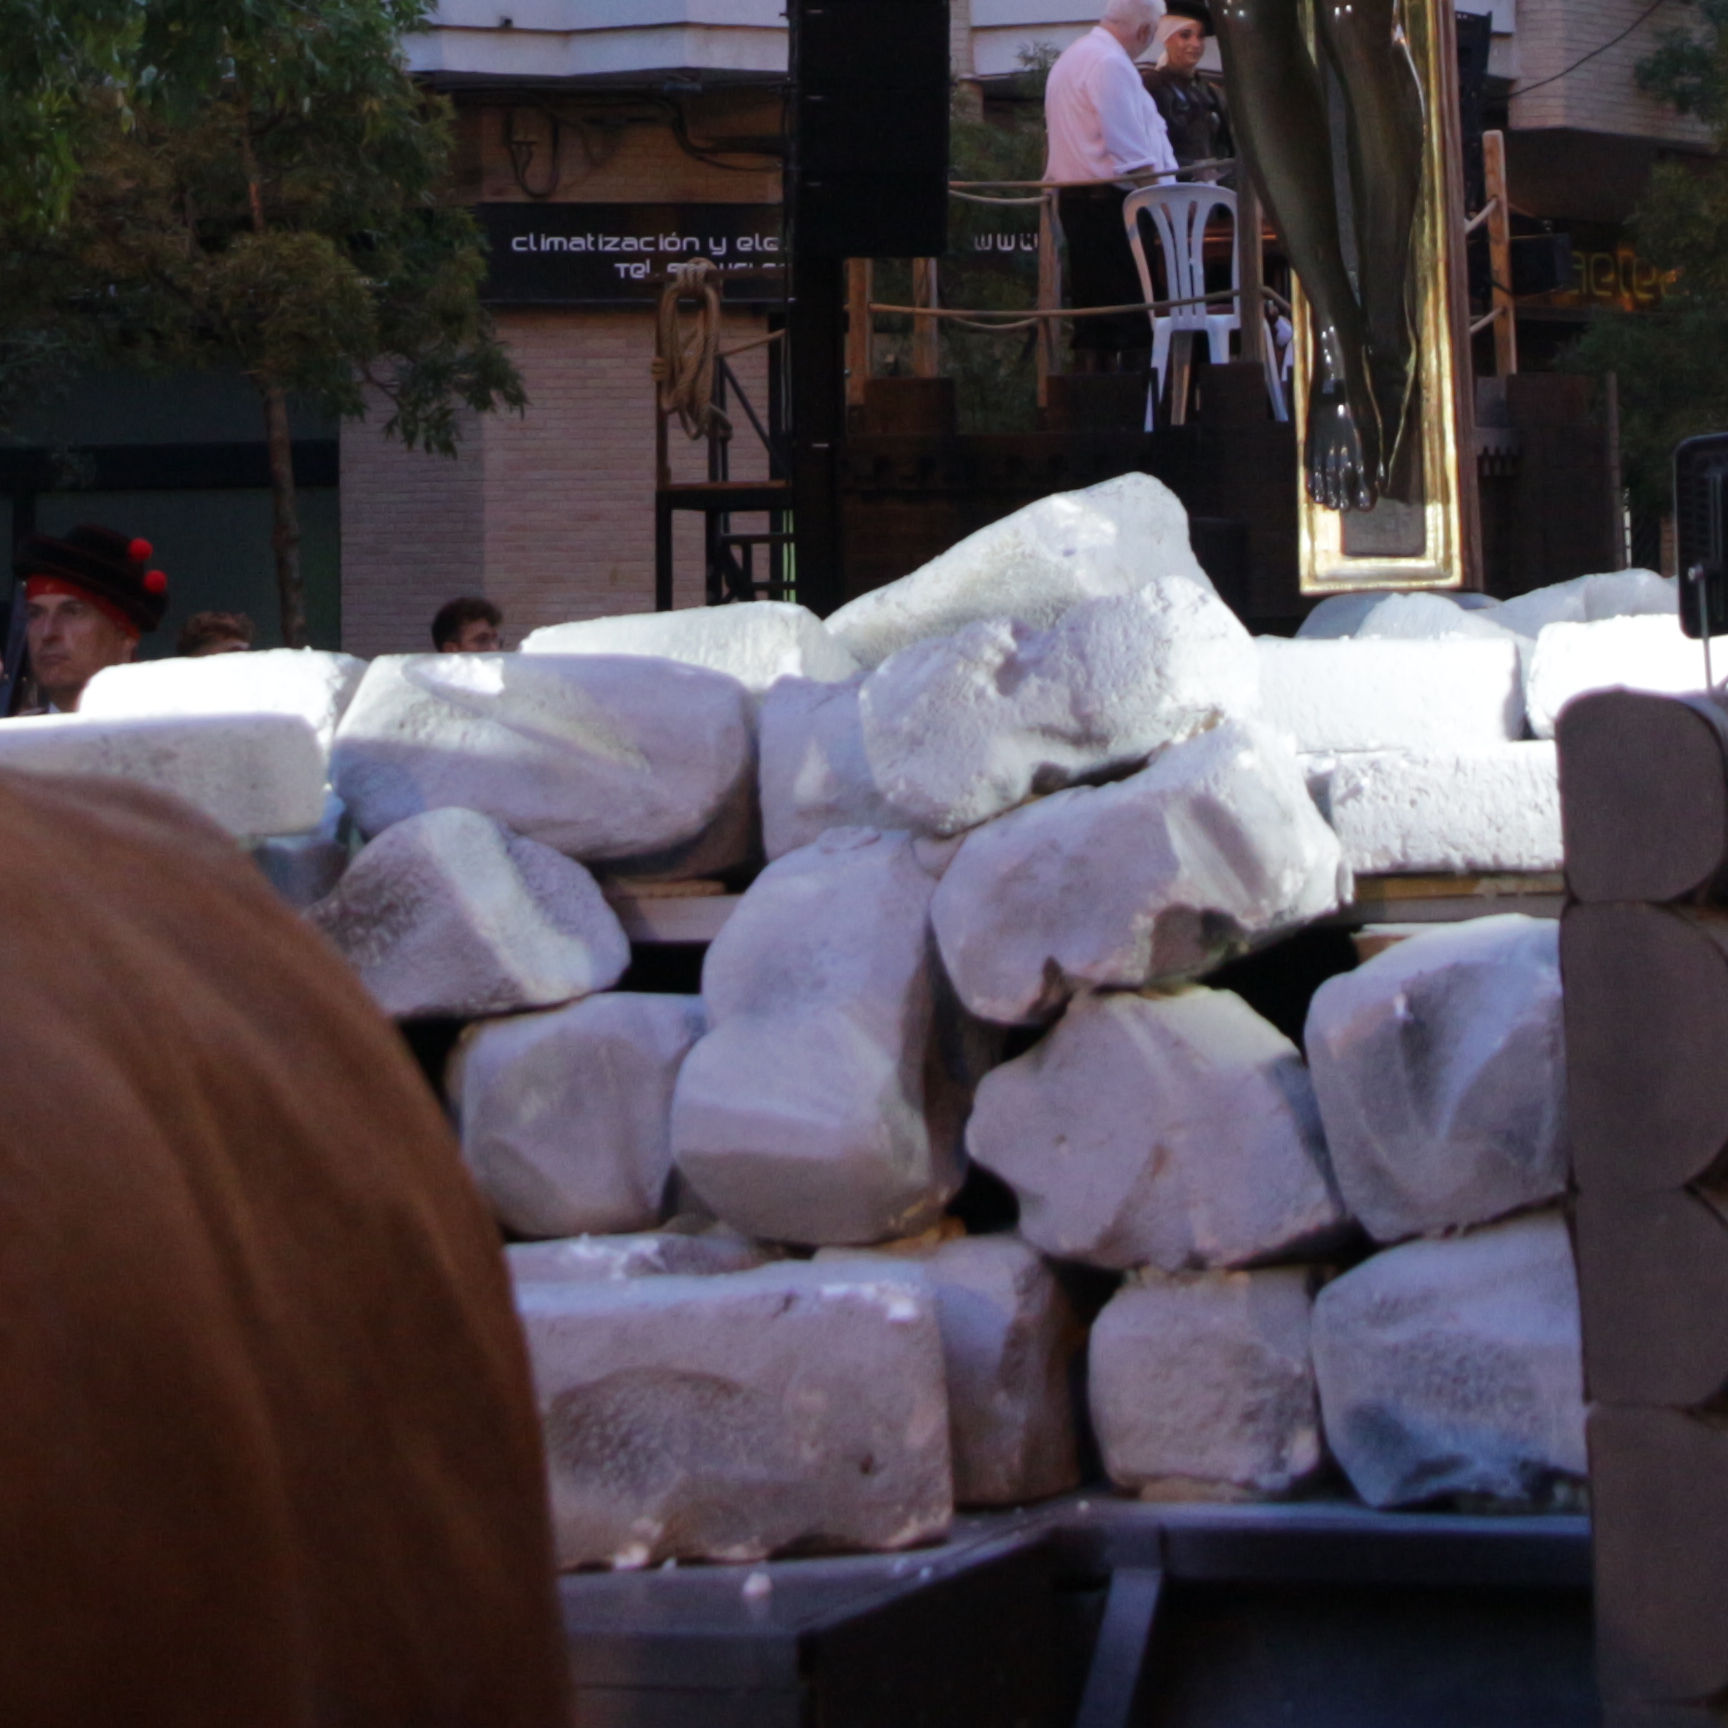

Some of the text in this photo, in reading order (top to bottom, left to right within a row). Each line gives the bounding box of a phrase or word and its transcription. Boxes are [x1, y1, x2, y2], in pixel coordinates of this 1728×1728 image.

[511, 231, 780, 255] climatización y ele
[974, 232, 1039, 252] www
